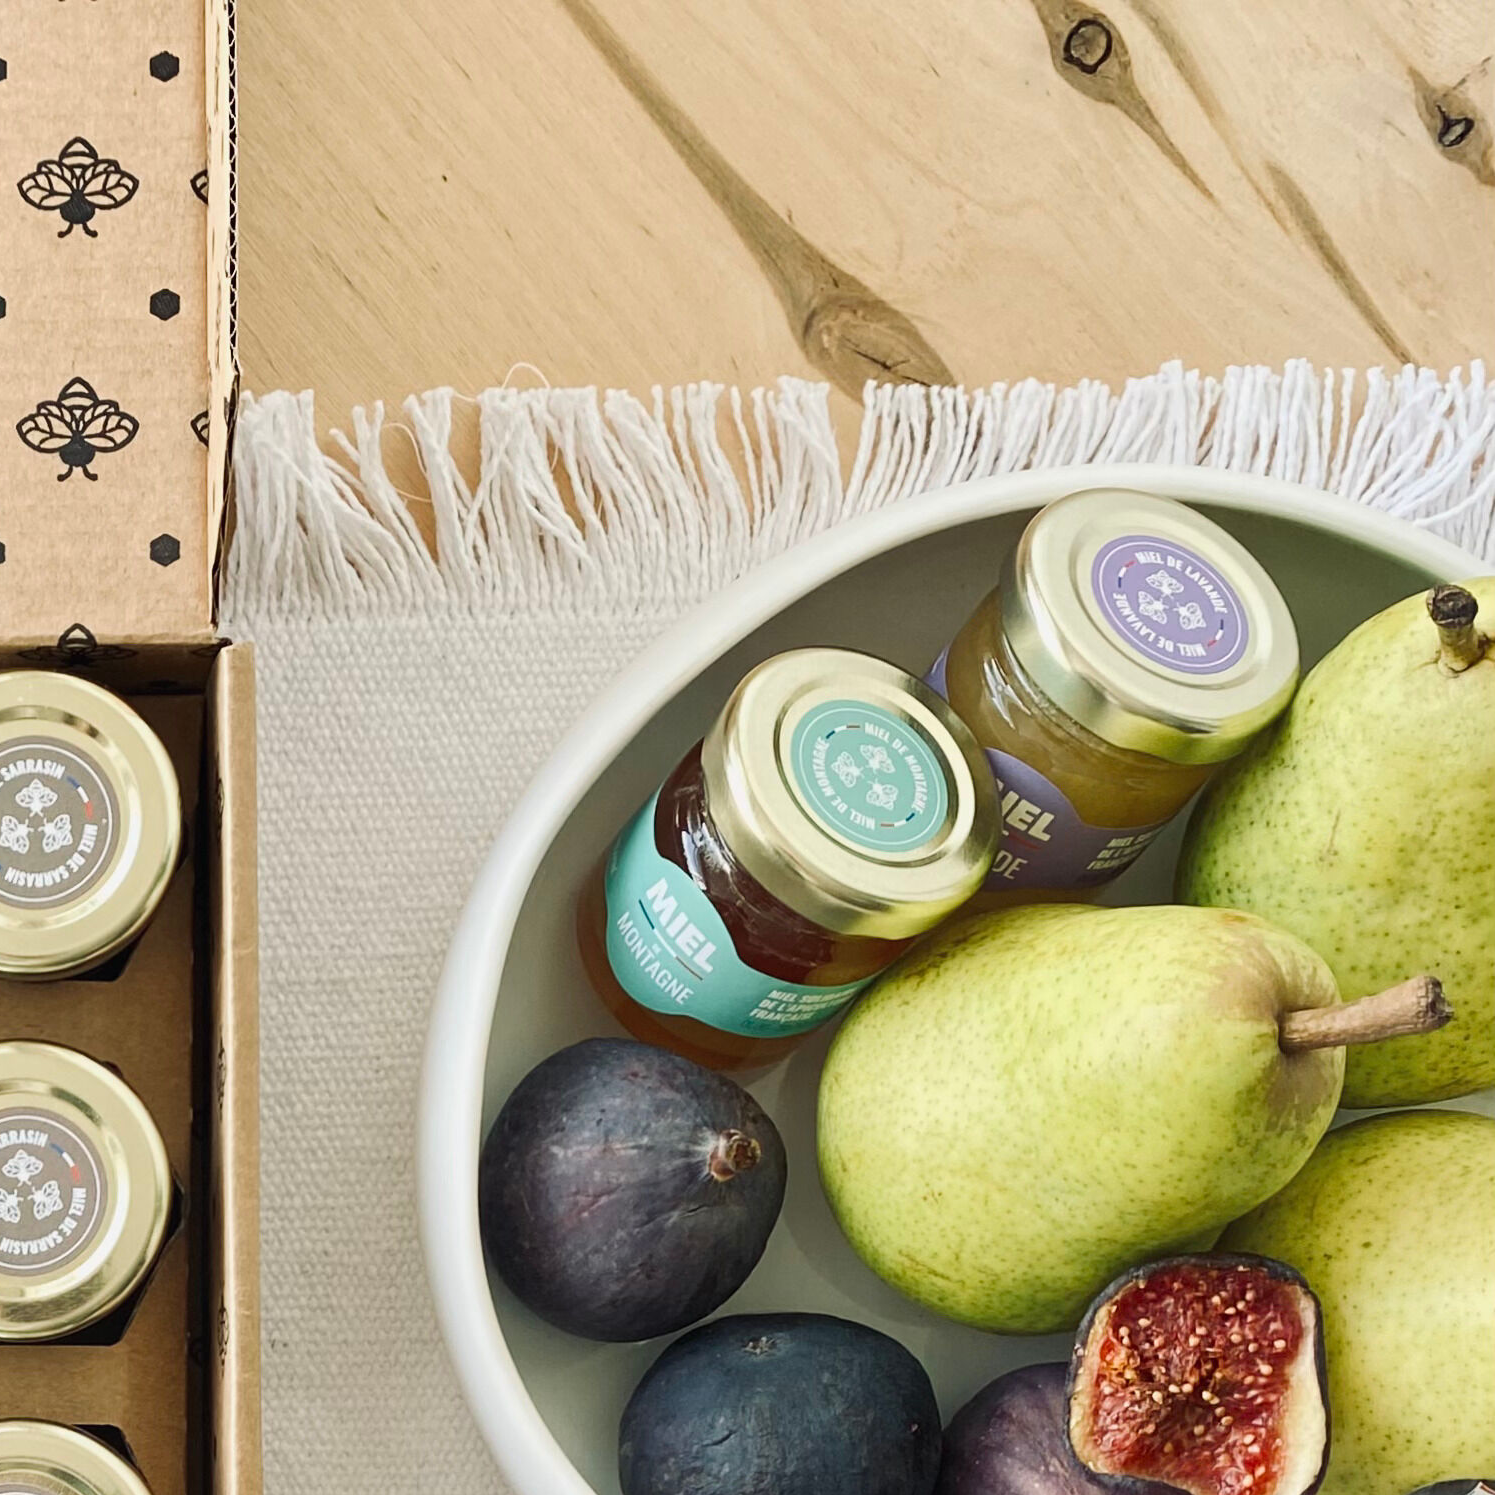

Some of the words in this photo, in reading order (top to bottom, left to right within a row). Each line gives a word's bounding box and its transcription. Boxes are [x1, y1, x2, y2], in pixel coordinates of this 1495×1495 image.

[1134, 552, 1164, 564] MIEL
[1167, 555, 1184, 571] DE
[1185, 566, 1228, 613] LAVANDE
[1113, 592, 1156, 642] LAVANDE
[1157, 636, 1174, 652] DE
[1176, 643, 1206, 656] MIEL
[0, 759, 65, 781] SARRASIN
[813, 736, 835, 796] MONTAGNE
[865, 722, 889, 743] MIEL
[892, 738, 909, 756] DE
[905, 755, 928, 814] MONTAGNE
[831, 796, 848, 814] DE
[996, 778, 1054, 841] IEL
[850, 808, 876, 830] MIEL
[77, 824, 97, 853] MIEL
[66, 852, 85, 872] DE
[5, 866, 69, 888] SARRASIN
[646, 877, 717, 973] MIEL
[617, 911, 694, 1005] MONTAGNE
[69, 1188, 86, 1216] MIEL
[59, 1216, 77, 1236] DE
[0, 1231, 63, 1255] SARRASIN
